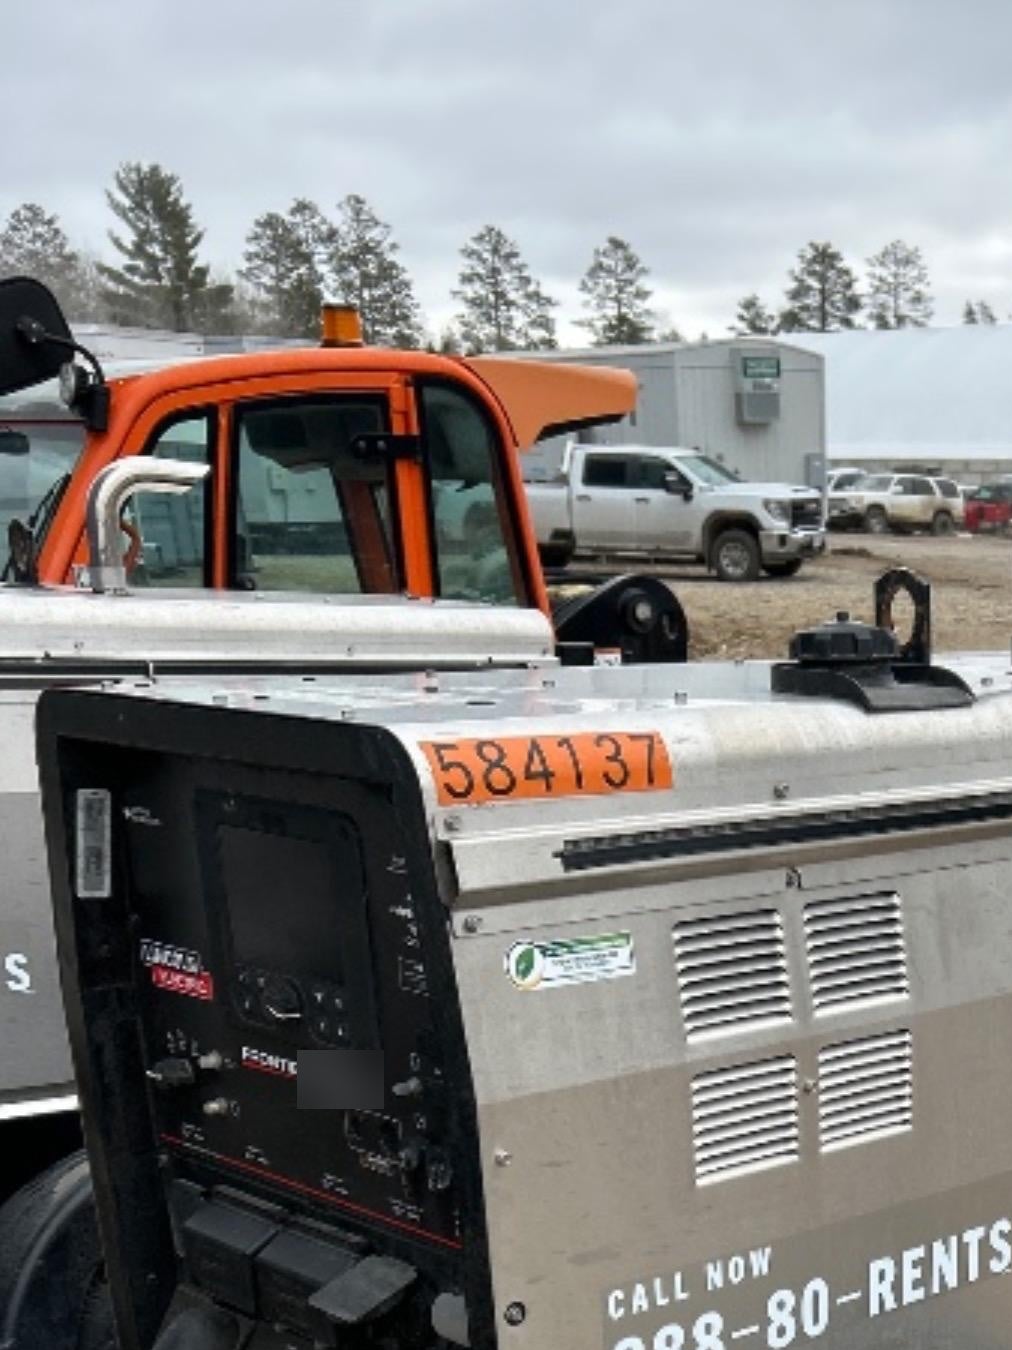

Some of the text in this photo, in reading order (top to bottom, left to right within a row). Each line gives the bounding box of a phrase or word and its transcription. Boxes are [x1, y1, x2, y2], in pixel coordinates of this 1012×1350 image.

[432, 734, 656, 800] 584137
[606, 1246, 773, 1321] CALL NOW
